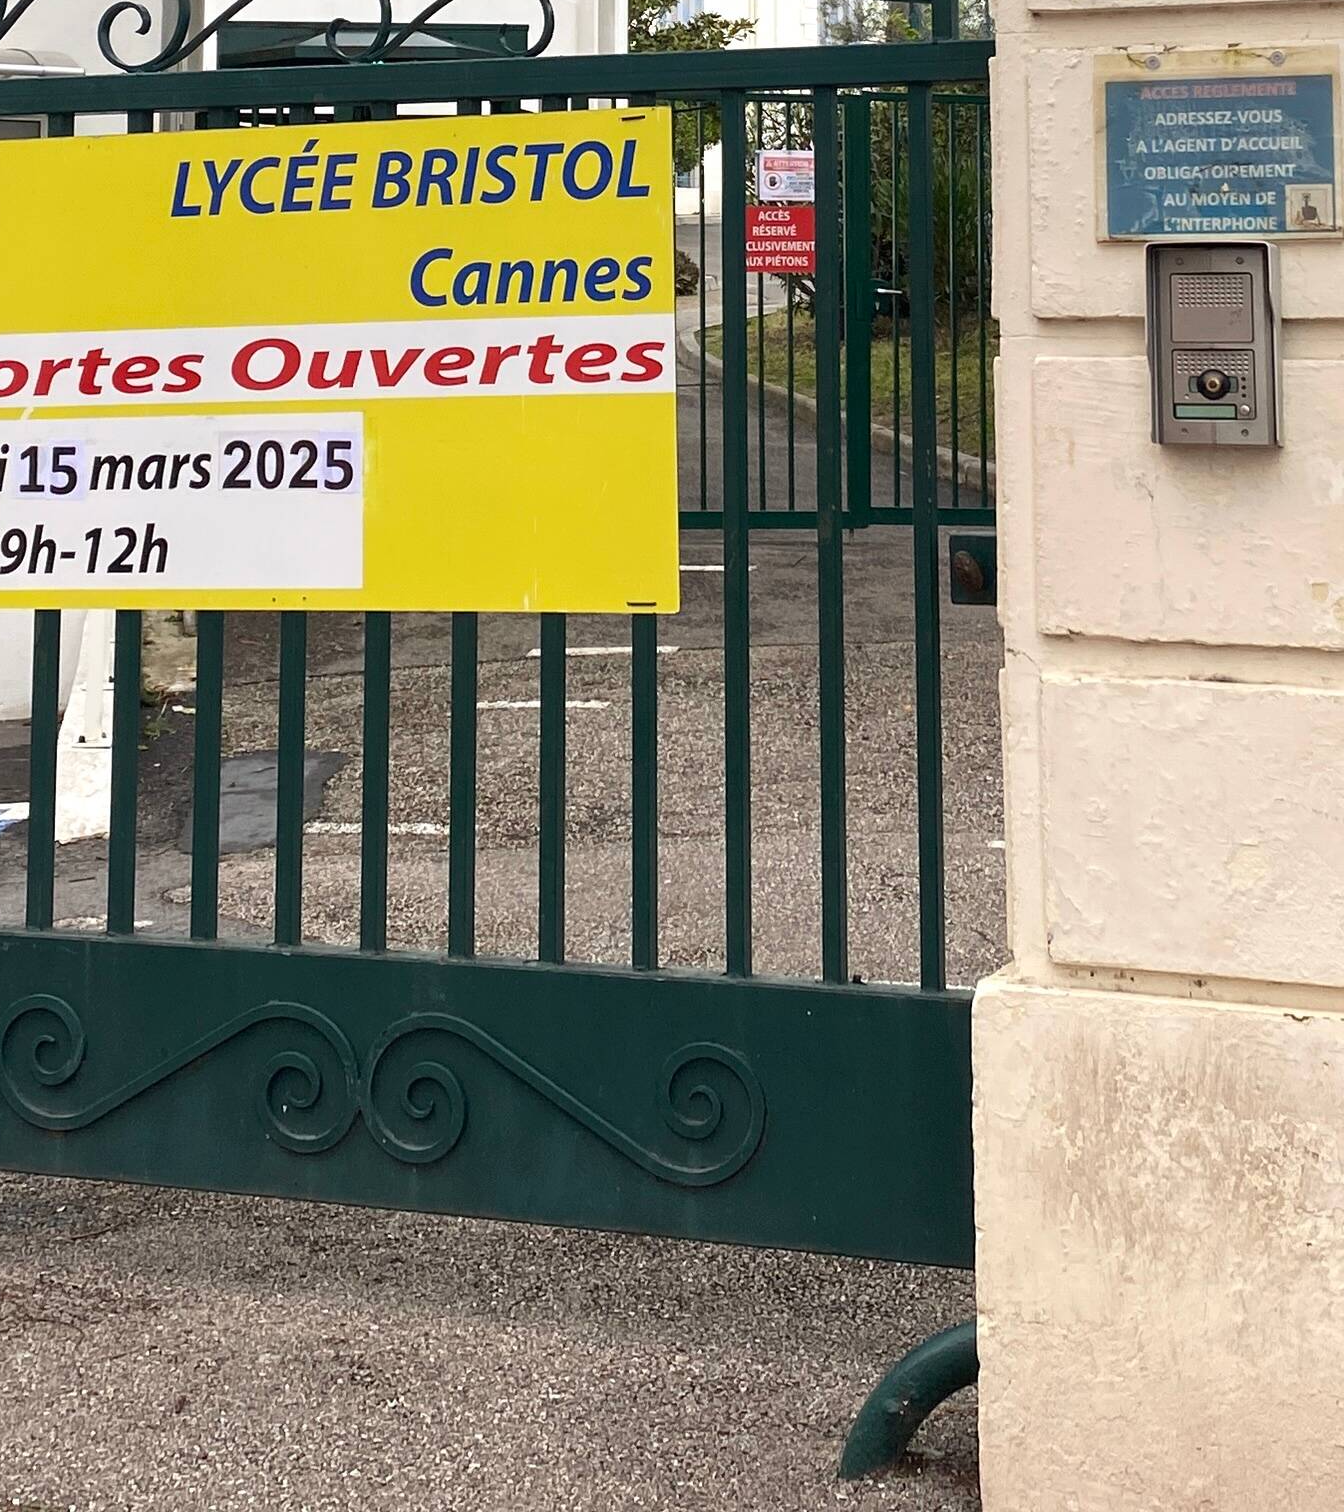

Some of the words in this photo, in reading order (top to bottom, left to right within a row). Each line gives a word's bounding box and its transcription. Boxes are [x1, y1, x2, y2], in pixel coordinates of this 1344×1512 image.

[1140, 85, 1189, 100] ACCES
[1155, 109, 1283, 126] ADRESSEZ-VOUS
[1136, 141, 1147, 154] A
[1152, 137, 1216, 154] L'AGENT
[1220, 136, 1304, 152] D'ACCUEIL
[170, 138, 354, 219] LYCÉE
[371, 140, 651, 210] BRISTOL
[1163, 193, 1187, 207] AU
[1191, 191, 1251, 206] MOYEN
[1255, 191, 1276, 205] DE
[758, 210, 791, 222] ACCÈS
[1163, 215, 1278, 232] L'INTERPHONE
[752, 224, 797, 236] RÉSERVÉ
[765, 254, 808, 267] PIÉTONS
[408, 247, 654, 309] Cannes
[230, 331, 666, 392] Ouvertes
[19, 445, 78, 496] 15
[89, 452, 212, 491] mars
[222, 439, 355, 491] 2025
[0, 522, 169, 575] 9h-12h
